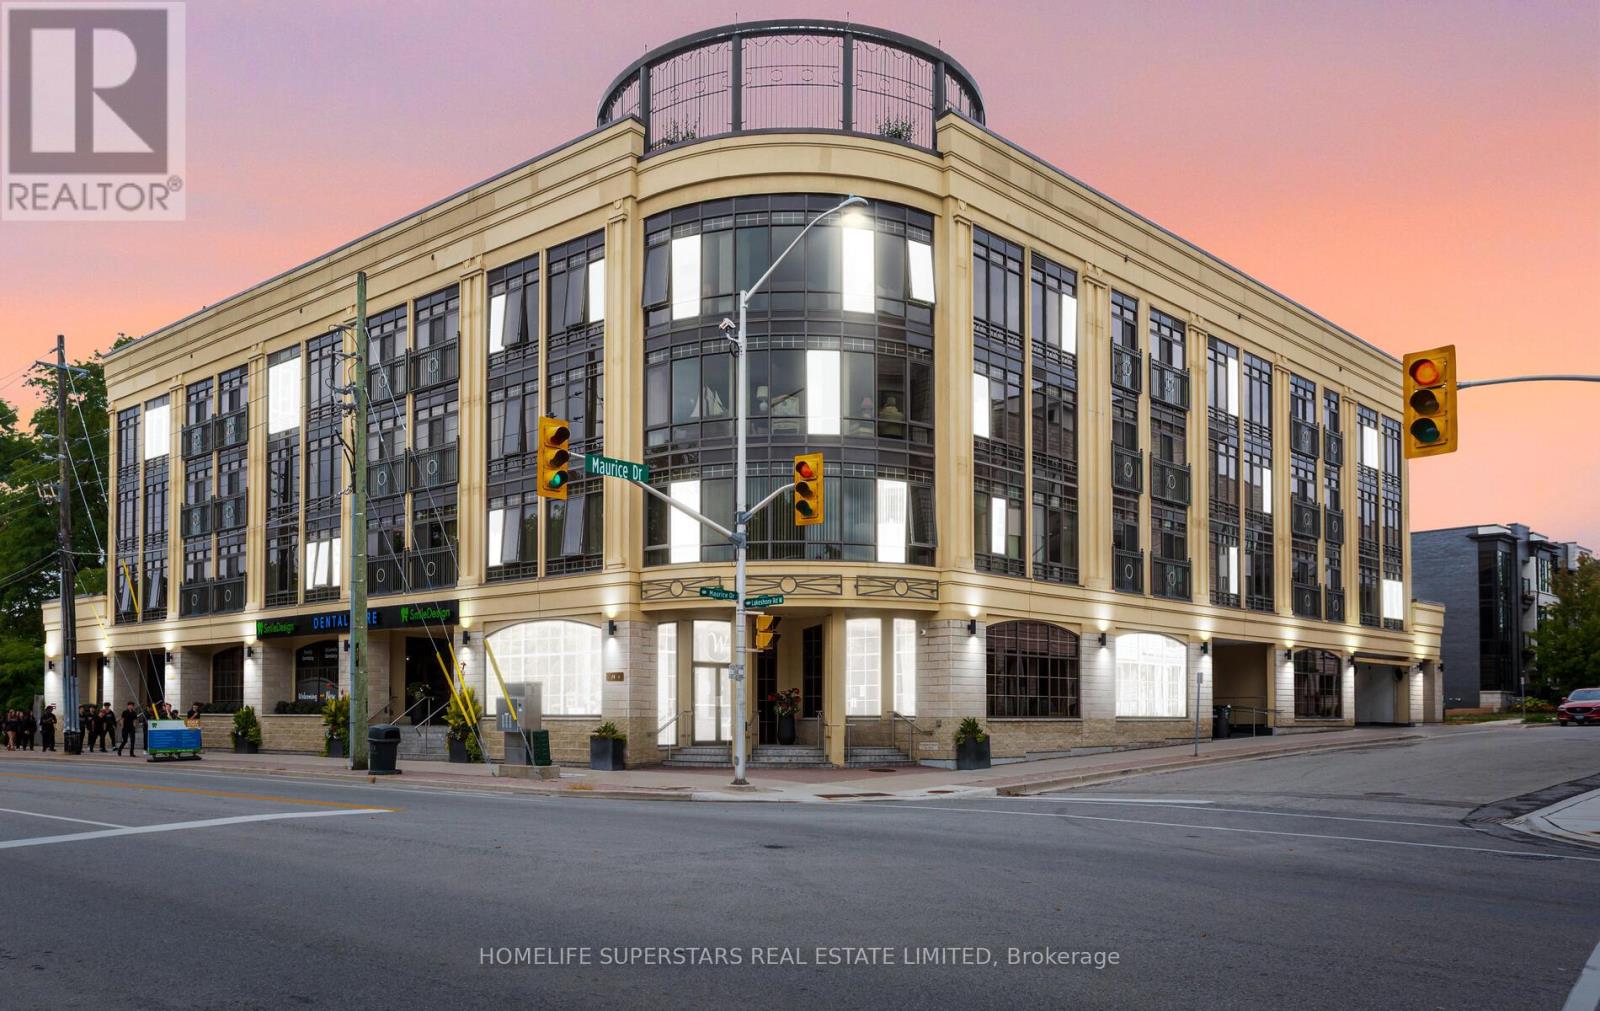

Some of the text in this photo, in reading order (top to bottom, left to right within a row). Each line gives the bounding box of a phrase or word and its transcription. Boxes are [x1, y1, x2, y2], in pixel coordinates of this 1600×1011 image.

[592, 456, 642, 480] Maurice Dr
[709, 590, 728, 598] Maurice
[410, 607, 451, 621] SmileDesign
[313, 614, 348, 630] DENTAL
